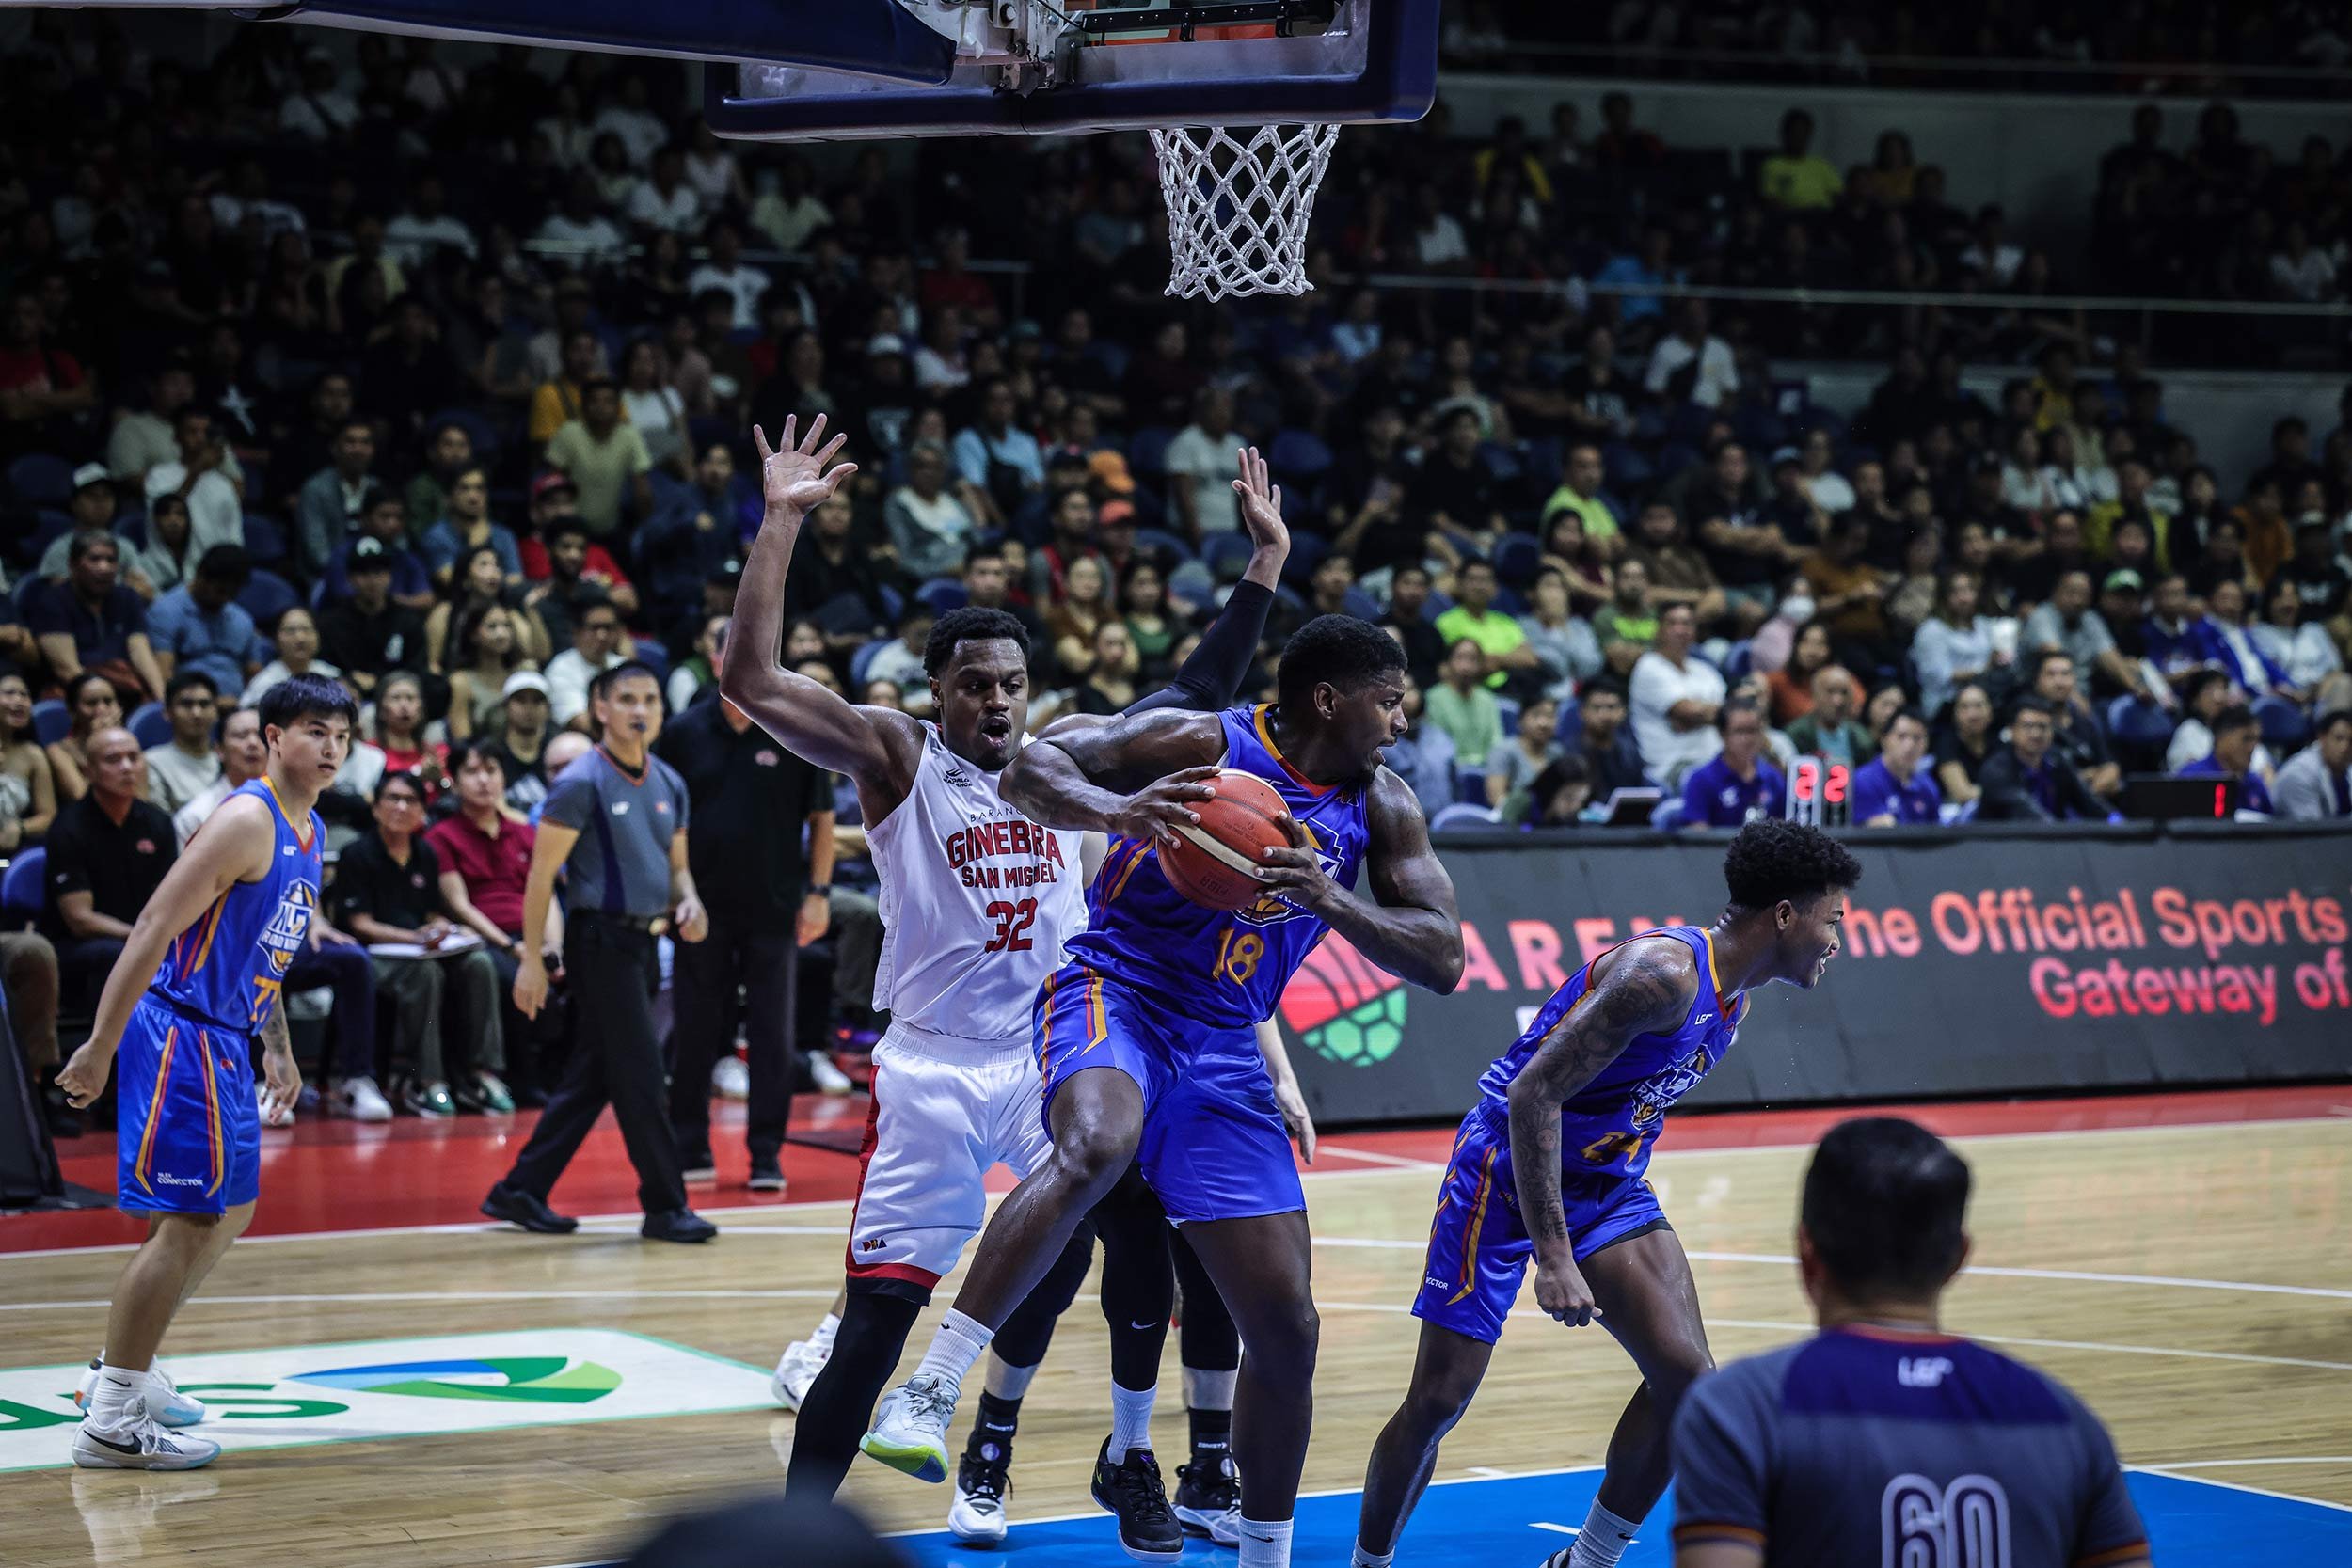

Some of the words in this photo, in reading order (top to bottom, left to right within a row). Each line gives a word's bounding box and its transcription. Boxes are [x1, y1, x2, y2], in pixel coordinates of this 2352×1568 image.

[1794, 763, 1850, 803] 22
[946, 820, 1066, 871] GINEBRA
[961, 866, 1000, 889] SAN
[1004, 863, 1057, 889] MIGUEL
[985, 896, 1038, 954] 32
[1840, 896, 1922, 958] he
[1931, 886, 2146, 955] Official
[2152, 886, 2349, 960] Sports
[1212, 927, 1265, 986] 18
[2028, 956, 2278, 1026] Gateway
[2293, 945, 2352, 1009] of
[1882, 1473, 2011, 1568] 60
